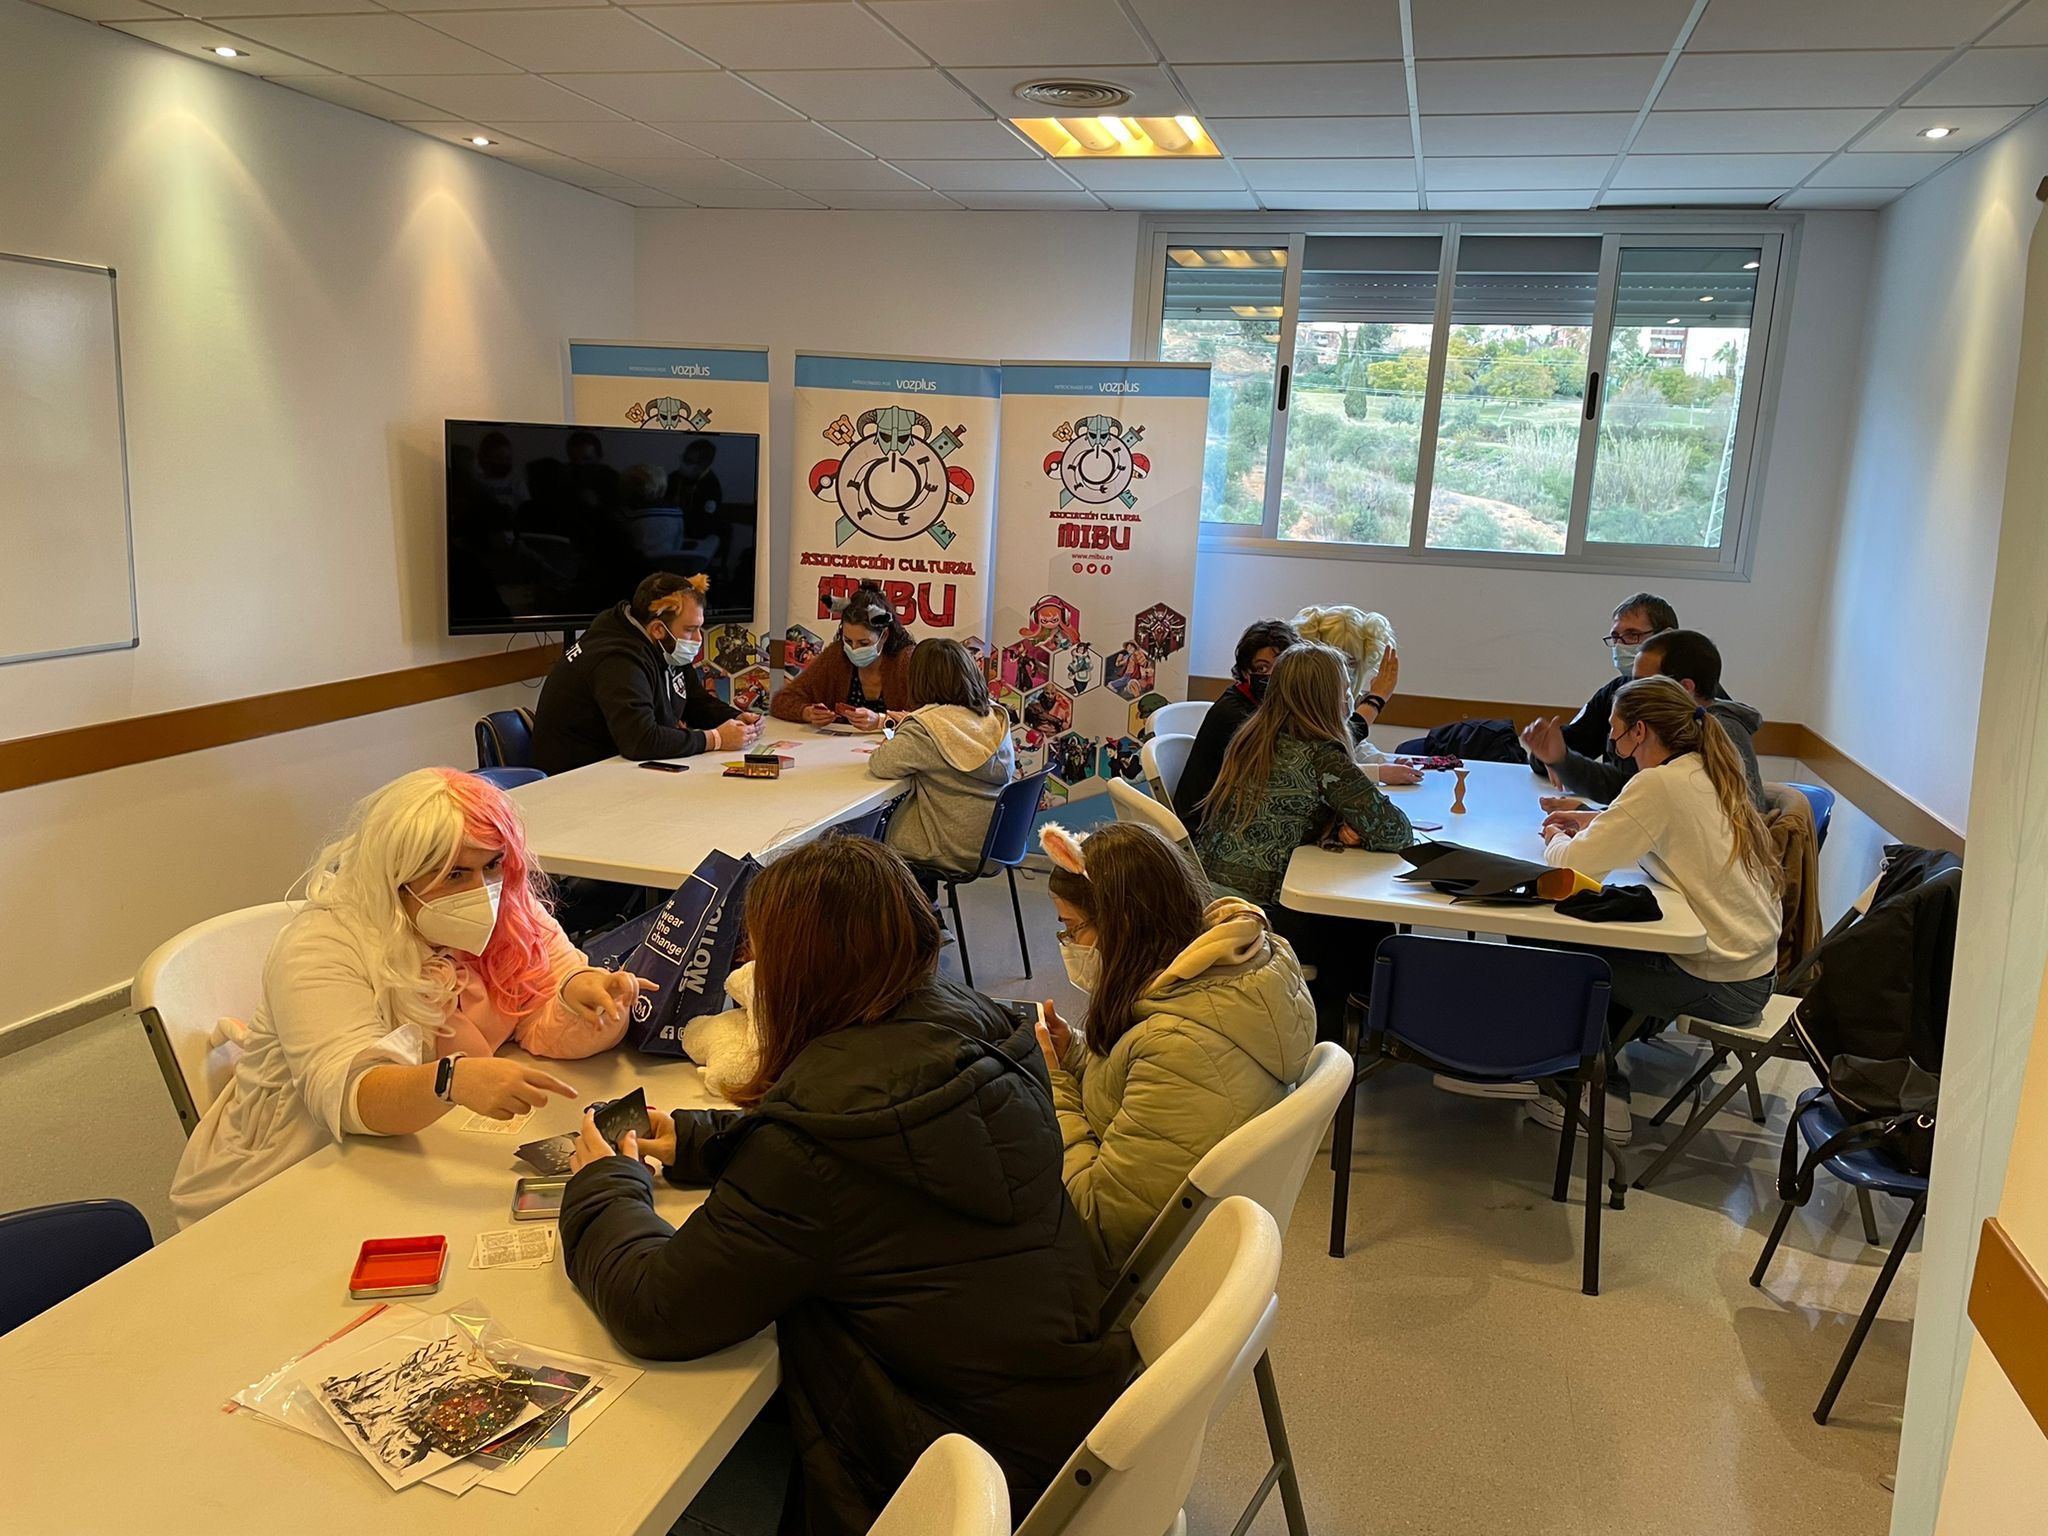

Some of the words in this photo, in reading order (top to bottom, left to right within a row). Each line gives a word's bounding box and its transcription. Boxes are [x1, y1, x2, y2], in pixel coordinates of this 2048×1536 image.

[671, 363, 710, 378] vozplus
[896, 378, 937, 392] vozplus
[1098, 379, 1140, 395] vozplus
[1100, 513, 1142, 522] CULTURAL
[1057, 522, 1131, 550] MIBU
[800, 552, 894, 571] ASOCIACIÓN
[898, 559, 976, 576] CULTURAL
[1071, 553, 1114, 561] www.mibu.es
[818, 574, 957, 627] MBU
[661, 911, 685, 928] wear
[656, 921, 671, 935] the
